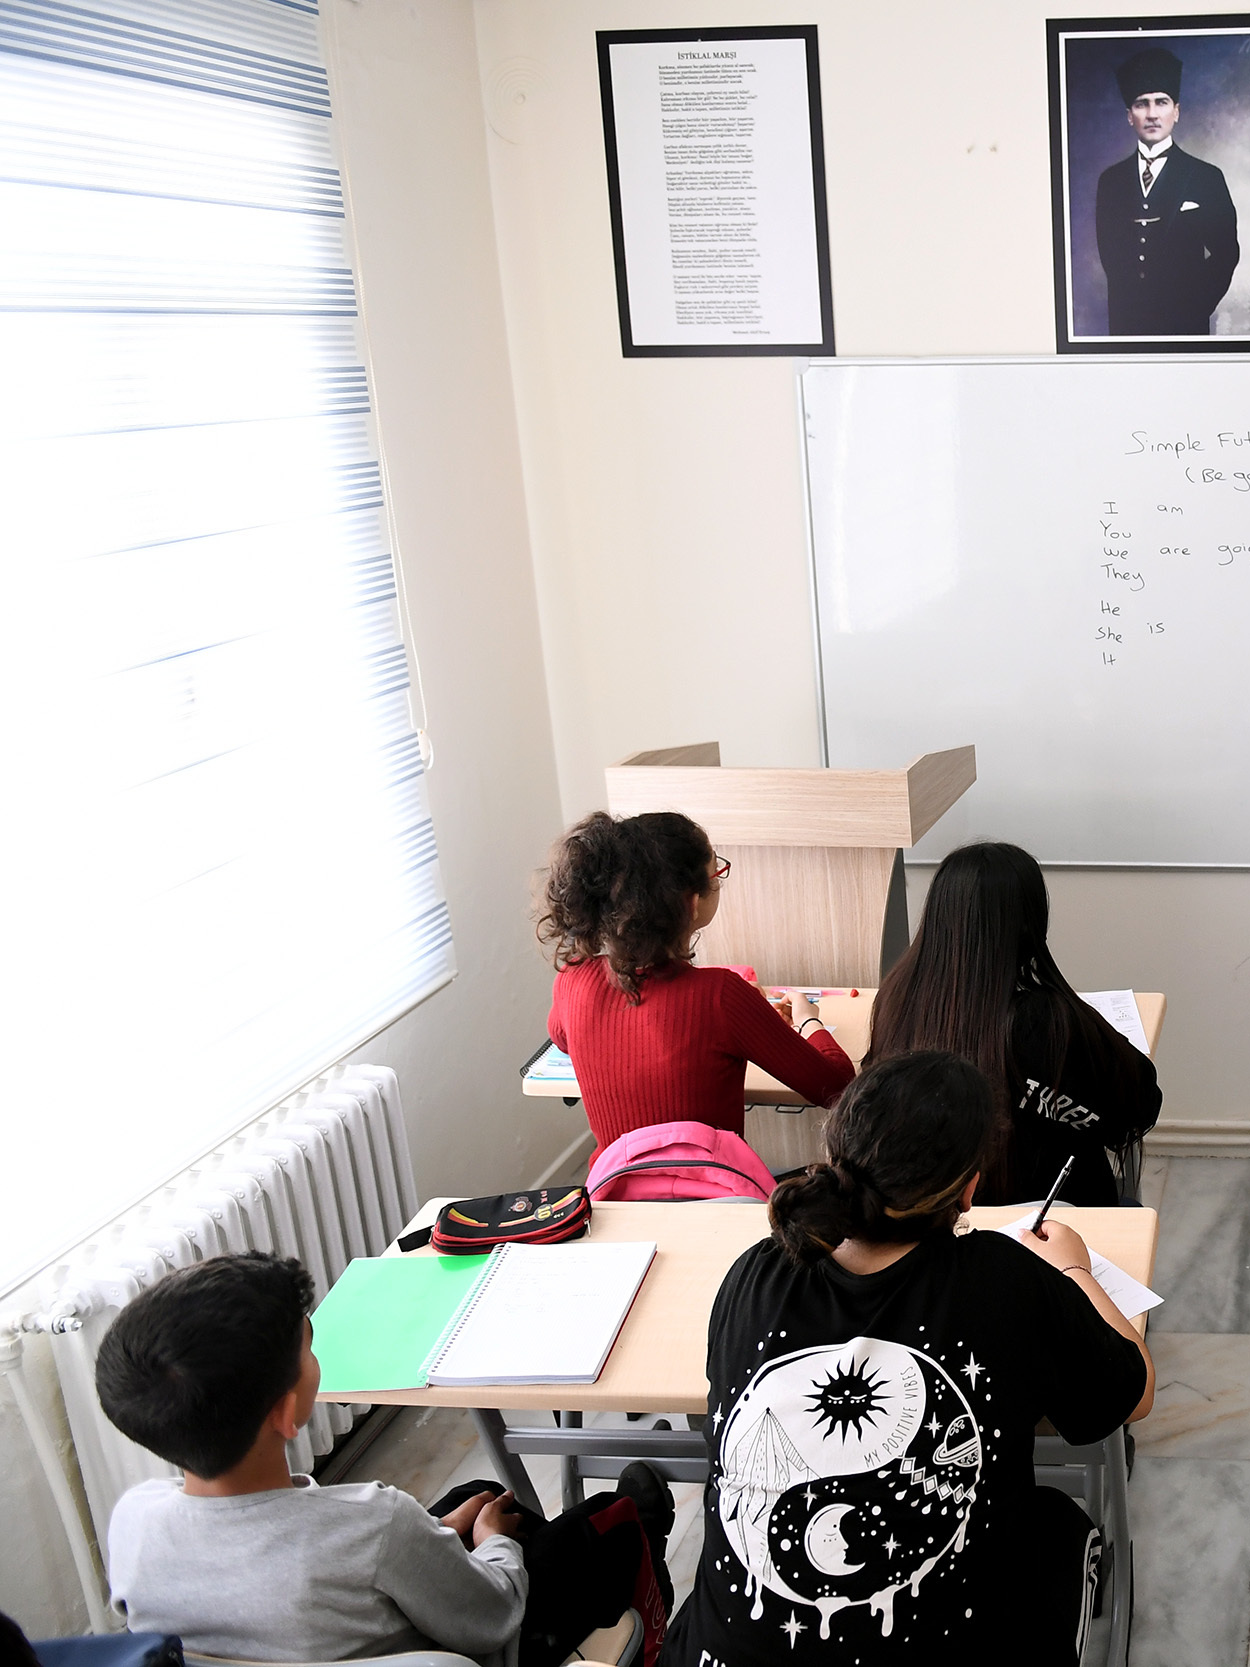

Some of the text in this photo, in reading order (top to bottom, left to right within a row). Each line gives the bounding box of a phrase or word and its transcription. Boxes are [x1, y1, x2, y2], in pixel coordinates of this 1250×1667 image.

[678, 51, 737, 60] İSTİKLAL MARŞI
[1125, 430, 1205, 458] Simple
[1103, 501, 1184, 515] I am
[1100, 520, 1132, 539] You
[1160, 546, 1191, 556] are
[1100, 563, 1145, 592] They
[1101, 600, 1120, 616] He
[1146, 622, 1165, 634] is
[1102, 652, 1116, 666] It
[1019, 1078, 1100, 1130] THREE
[864, 1366, 918, 1468] MY POSITIVE VIBES
